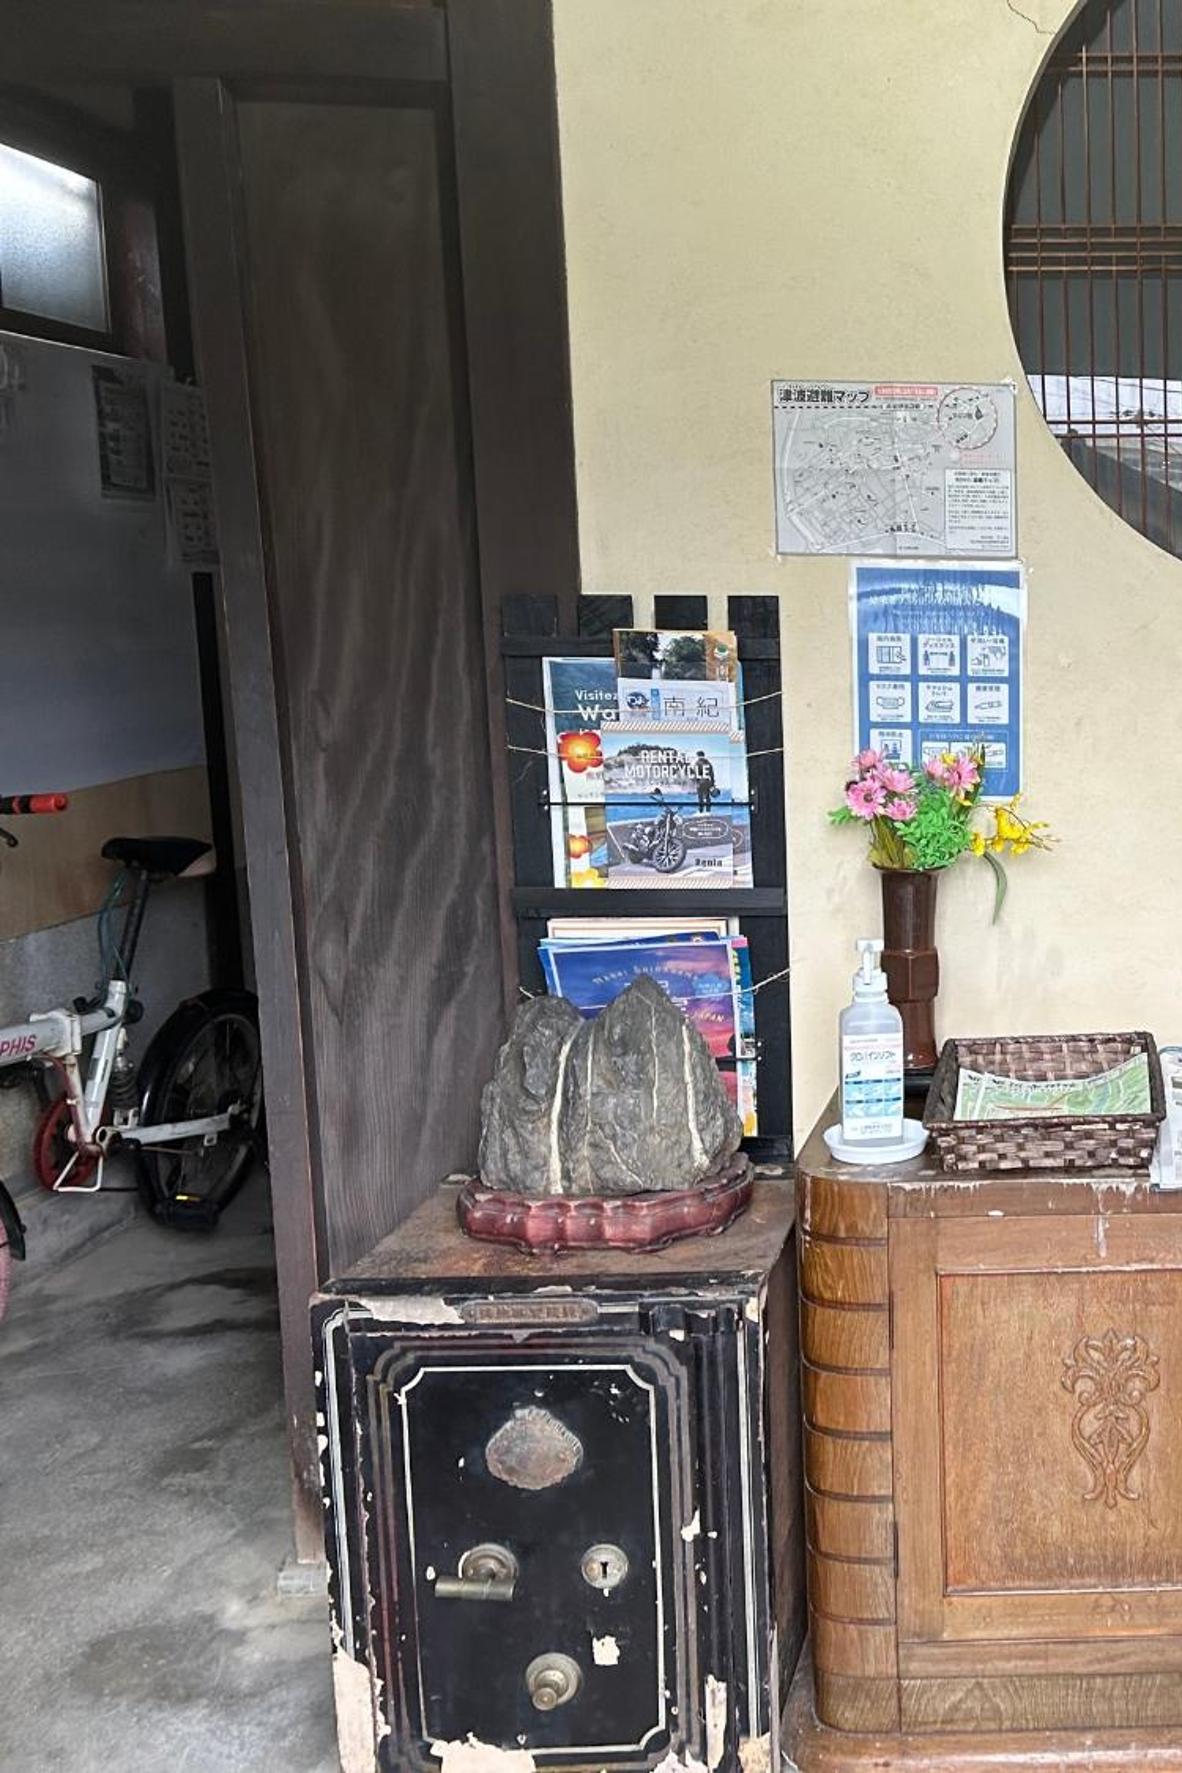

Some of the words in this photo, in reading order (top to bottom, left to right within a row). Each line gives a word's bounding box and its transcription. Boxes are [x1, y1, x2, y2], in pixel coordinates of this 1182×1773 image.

[779, 388, 870, 403] 津波避難マップ
[663, 696, 720, 718] 南紀
[624, 764, 711, 779] MOTORCYCLE
